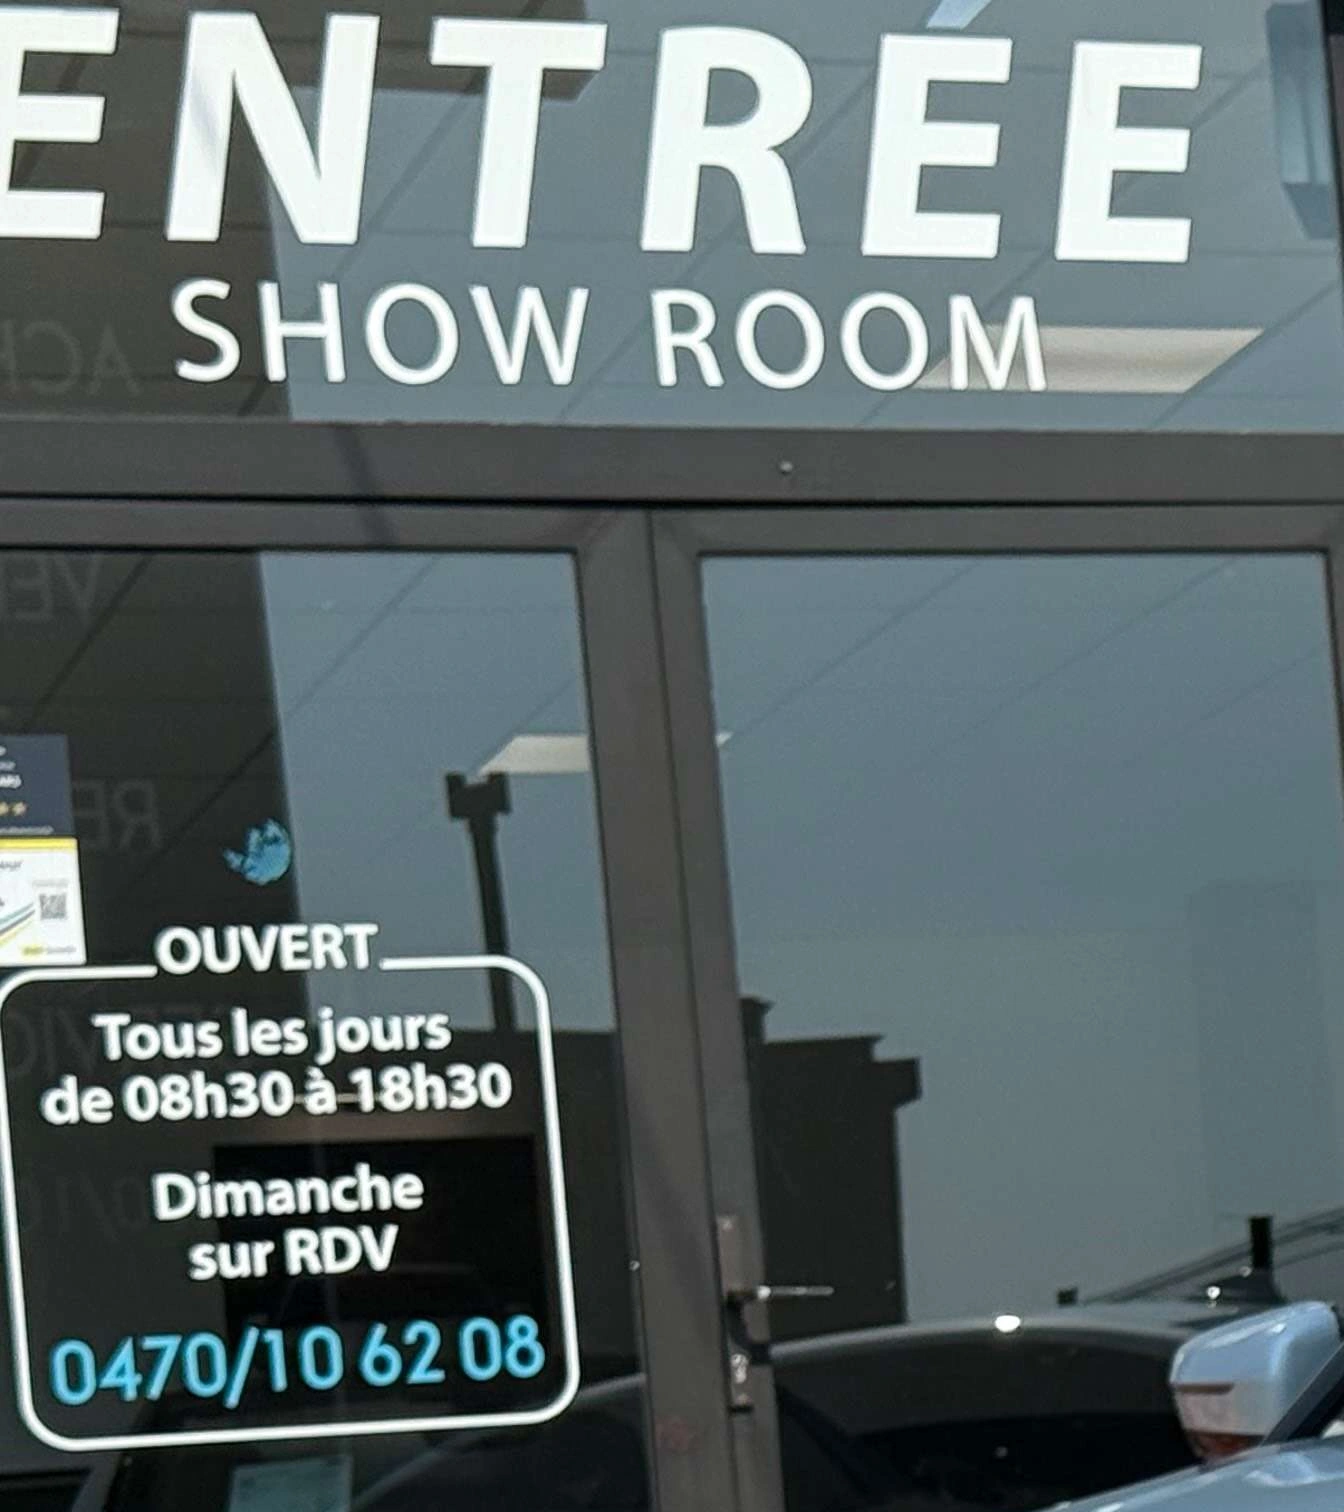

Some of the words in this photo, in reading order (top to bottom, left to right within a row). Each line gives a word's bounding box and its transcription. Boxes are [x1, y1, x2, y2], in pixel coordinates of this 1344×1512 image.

[173, 279, 589, 386] SHOW
[650, 289, 1047, 391] ROOM
[154, 922, 380, 975] OUVERT
[91, 1012, 224, 1062] Tous
[232, 1007, 309, 1057] les
[315, 1006, 452, 1066] jours
[41, 1074, 115, 1126] de
[121, 1066, 294, 1121] 08h30
[304, 1065, 338, 1115] à
[348, 1061, 512, 1114] 18h30
[151, 1162, 425, 1222] Dimanche
[187, 1238, 274, 1282] sur
[283, 1223, 400, 1277] RDV
[48, 1324, 346, 1410] 0470/10
[358, 1319, 446, 1386] 62
[457, 1314, 547, 1382] 08
